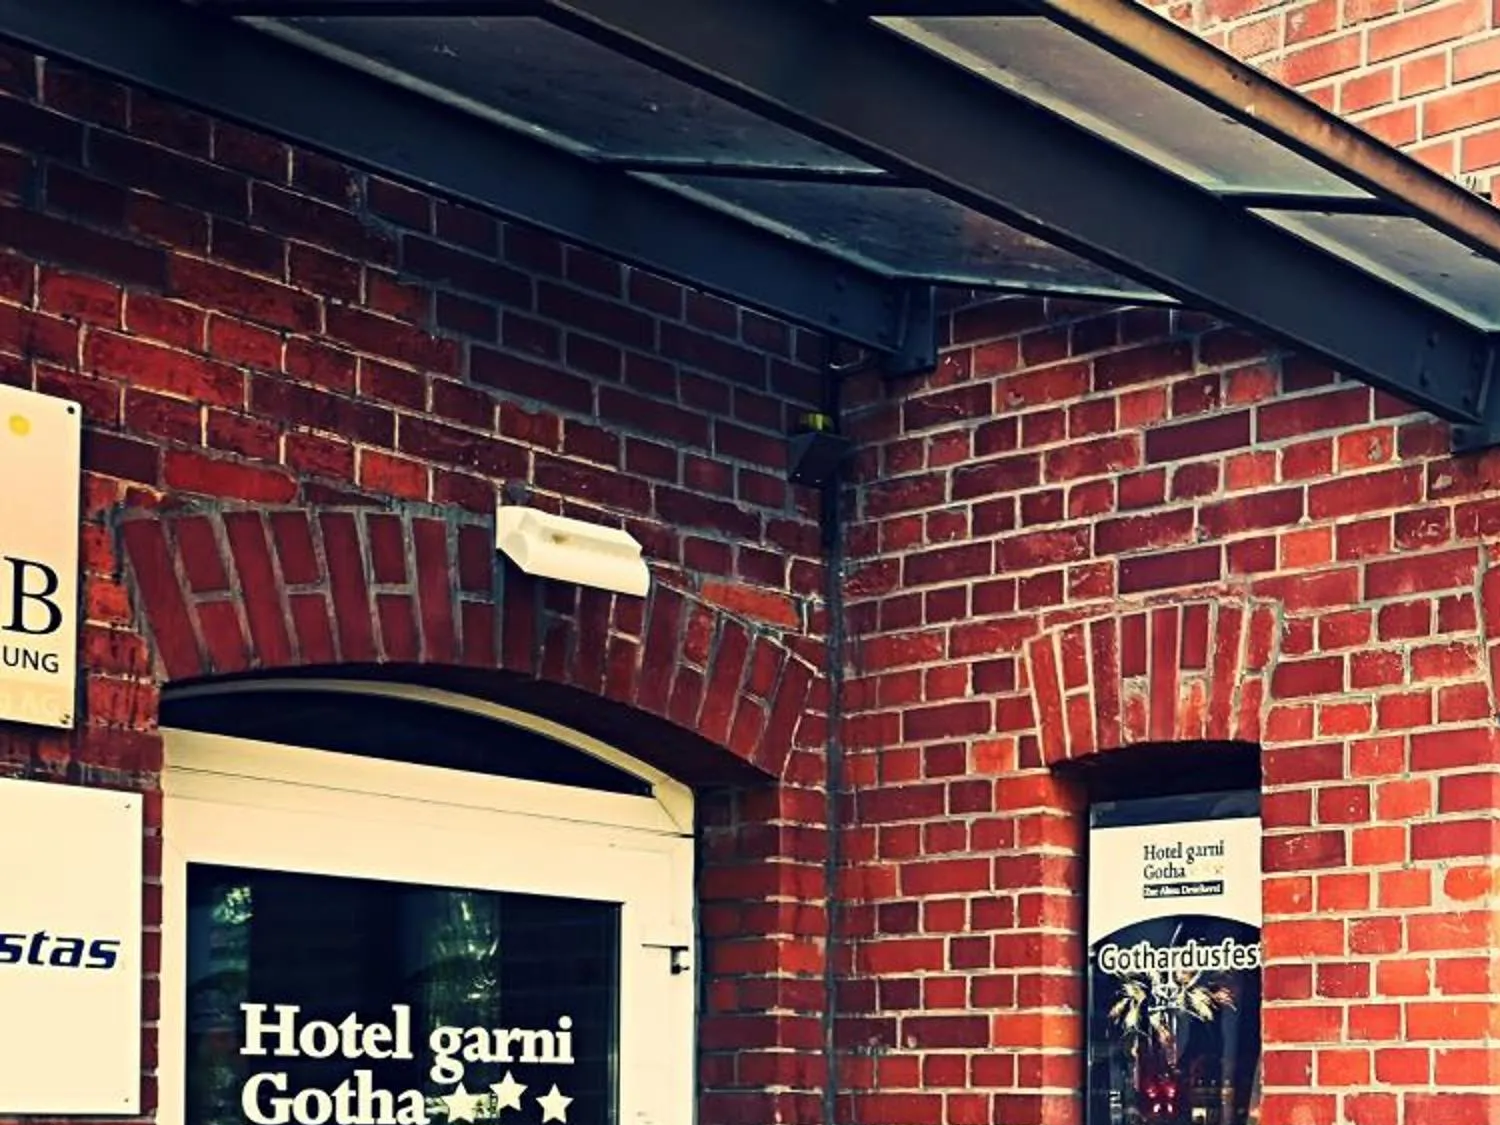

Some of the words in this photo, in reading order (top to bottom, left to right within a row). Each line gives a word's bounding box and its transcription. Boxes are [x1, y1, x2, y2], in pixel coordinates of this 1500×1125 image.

[3, 645, 60, 674] UNG
[1143, 841, 1183, 861] Hotel
[1186, 840, 1225, 864] garni
[1143, 862, 1186, 880] Gotha
[1100, 939, 1262, 972] Gothardusfes
[239, 1003, 413, 1060] Hotel
[429, 1015, 575, 1084] garni
